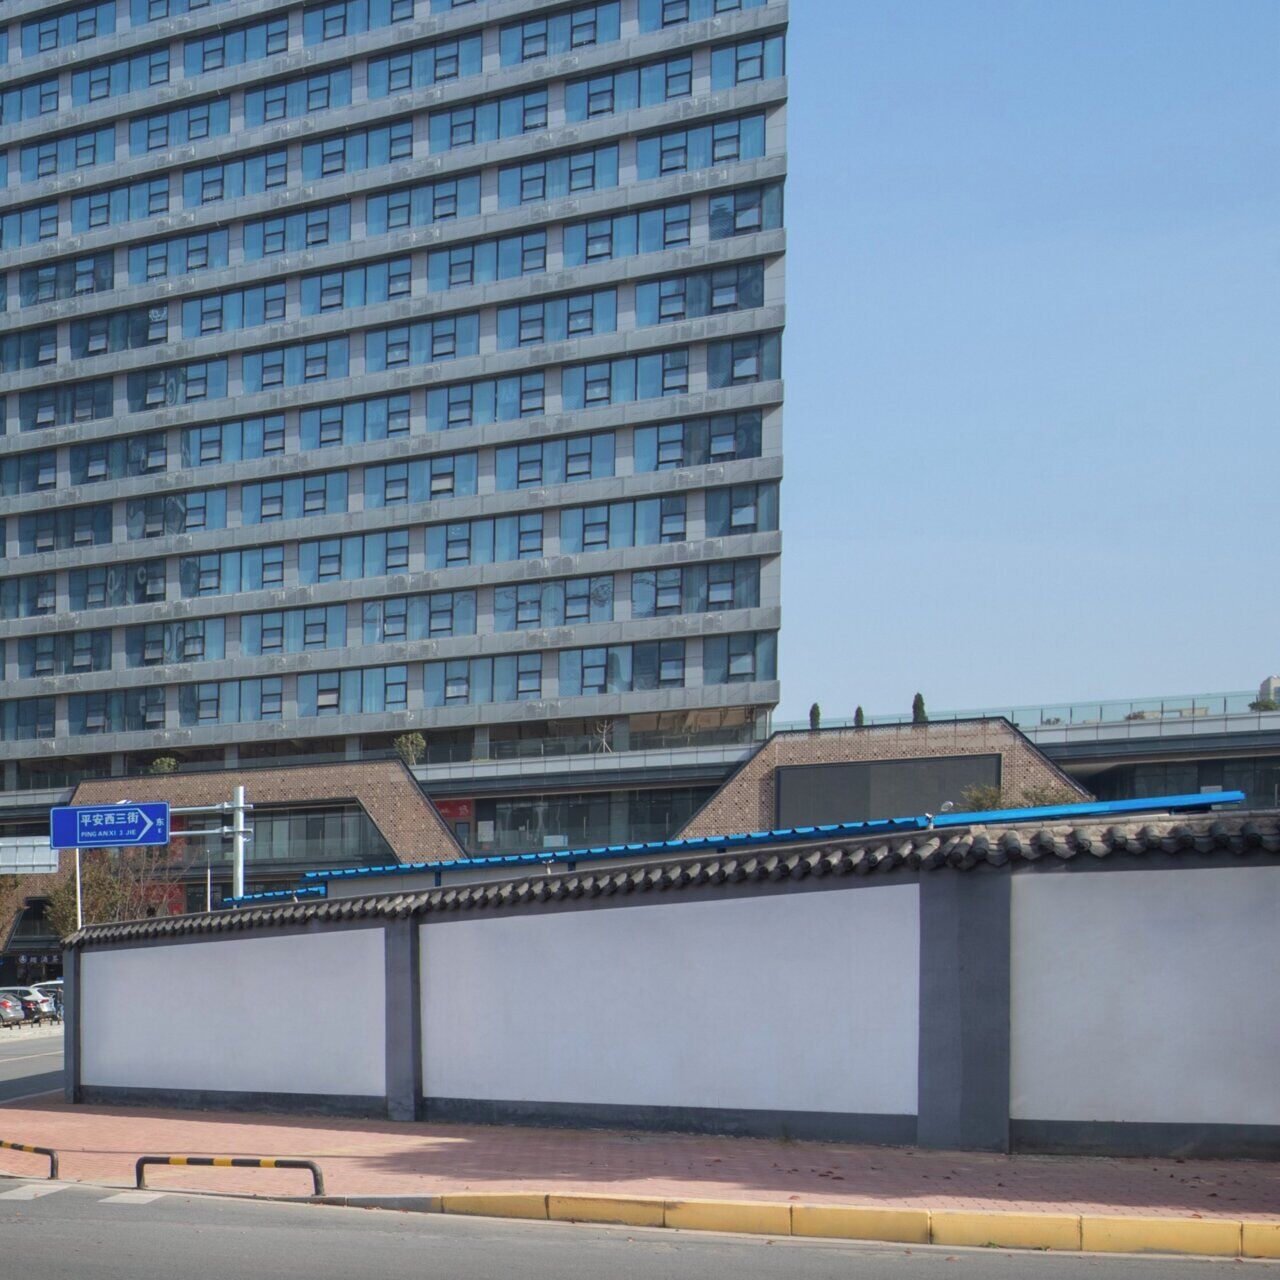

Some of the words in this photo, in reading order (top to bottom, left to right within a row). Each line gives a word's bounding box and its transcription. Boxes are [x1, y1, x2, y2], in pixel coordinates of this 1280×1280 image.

[81, 812, 139, 826] 平安西三街
[156, 818, 164, 826] 东
